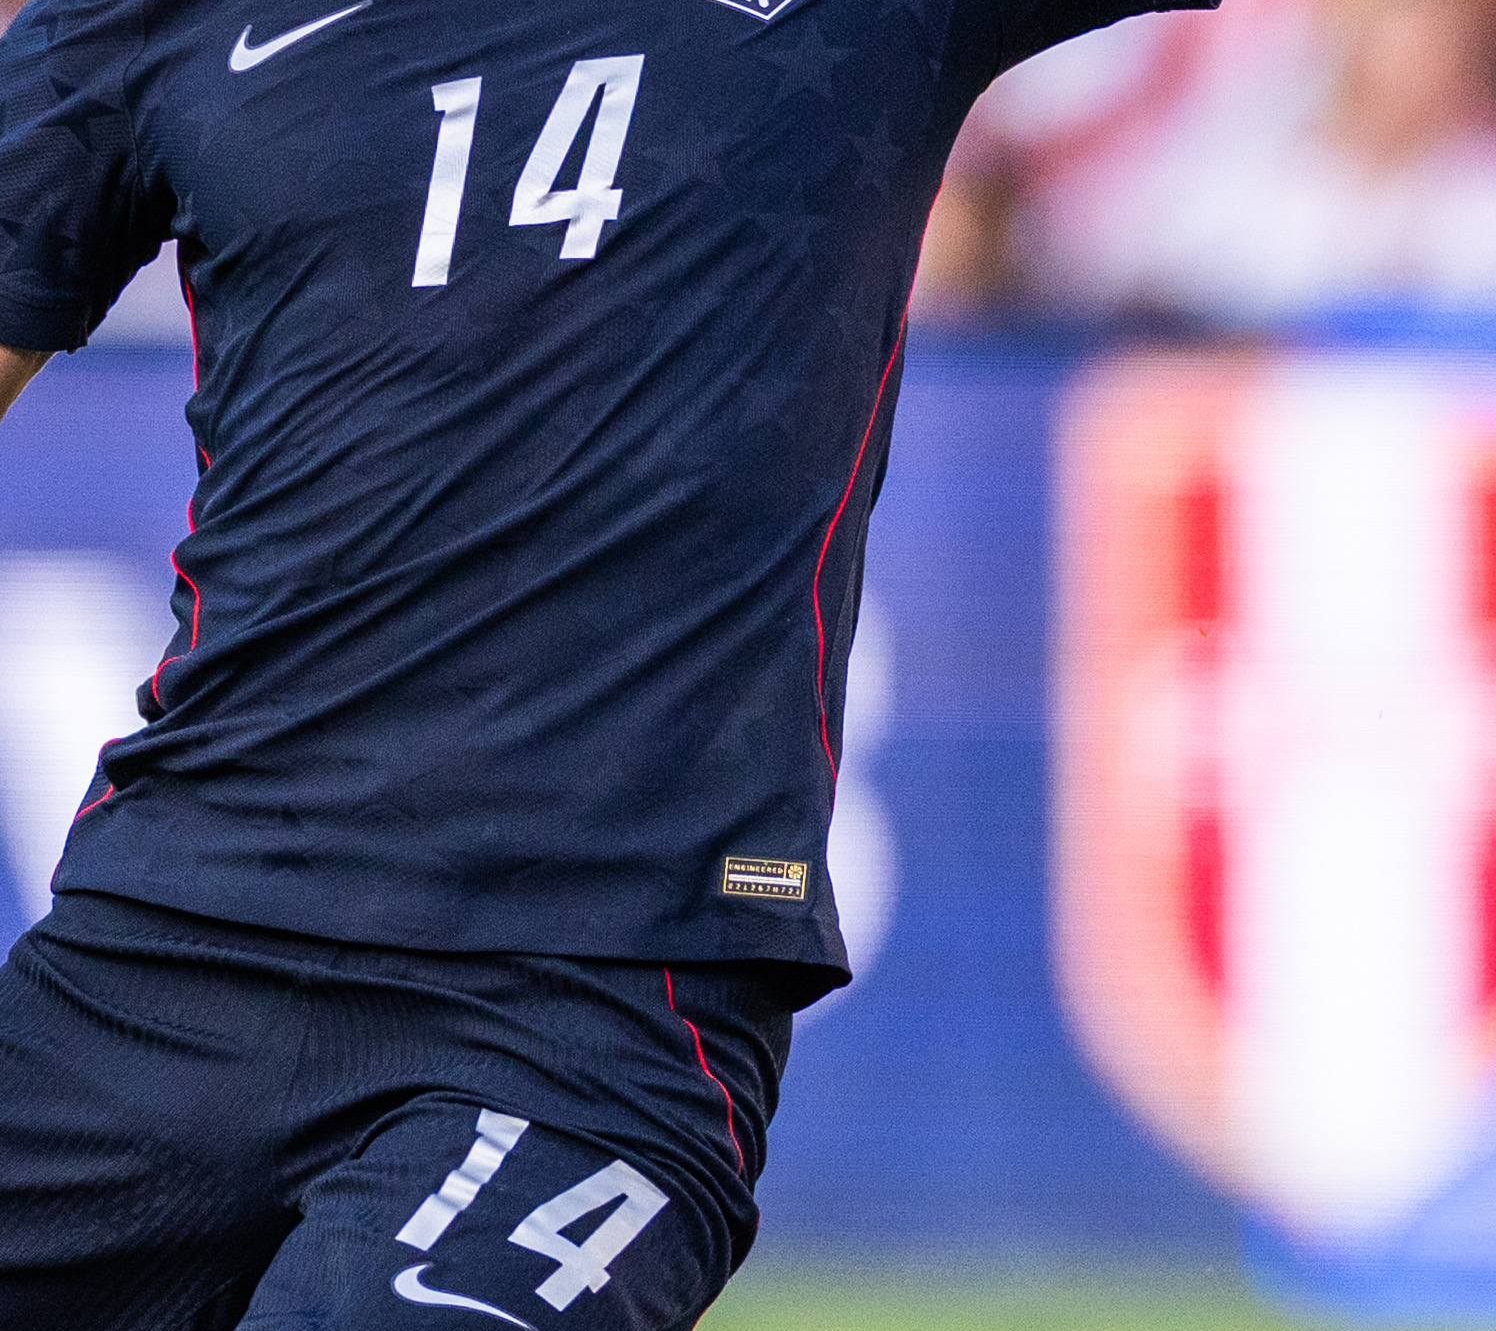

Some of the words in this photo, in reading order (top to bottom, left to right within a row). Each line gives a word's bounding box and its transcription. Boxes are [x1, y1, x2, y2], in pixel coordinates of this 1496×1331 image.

[411, 54, 645, 287] 14
[728, 863, 784, 874] ENGINEERED
[395, 1108, 670, 1311] 14
